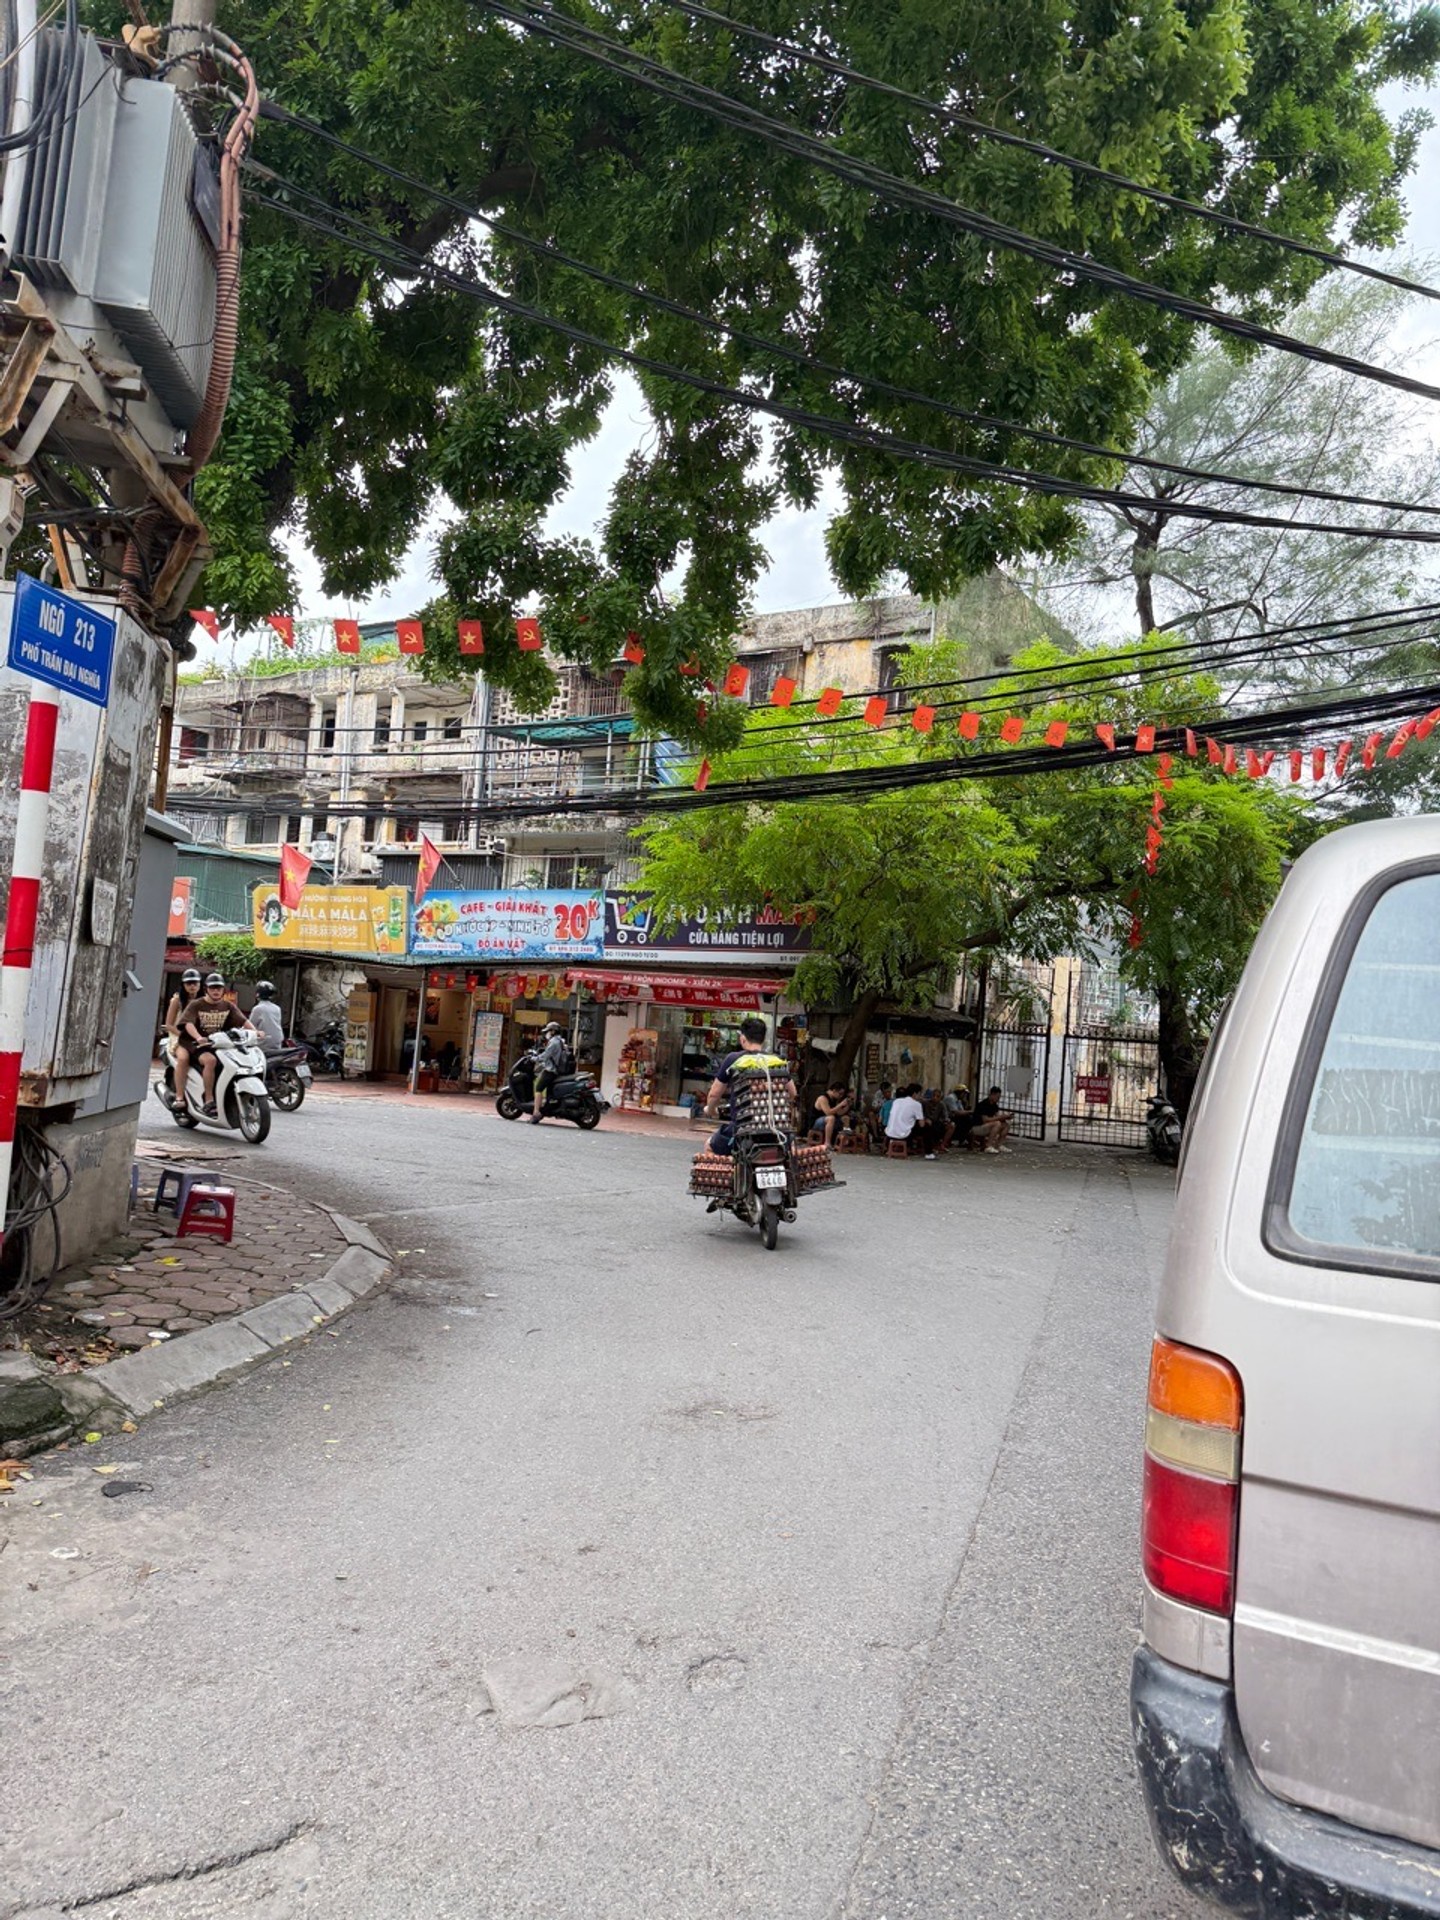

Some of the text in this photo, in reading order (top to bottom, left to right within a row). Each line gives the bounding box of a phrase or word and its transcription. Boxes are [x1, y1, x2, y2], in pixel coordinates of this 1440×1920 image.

[39, 599, 96, 652] NGÕ 213
[21, 640, 41, 662] PHỐ
[460, 901, 486, 915] CAFE
[495, 896, 517, 912] GIẢI
[689, 929, 784, 948] CỬA HÀNG TIỆN LỢI
[653, 976, 687, 986] INDOMIE
